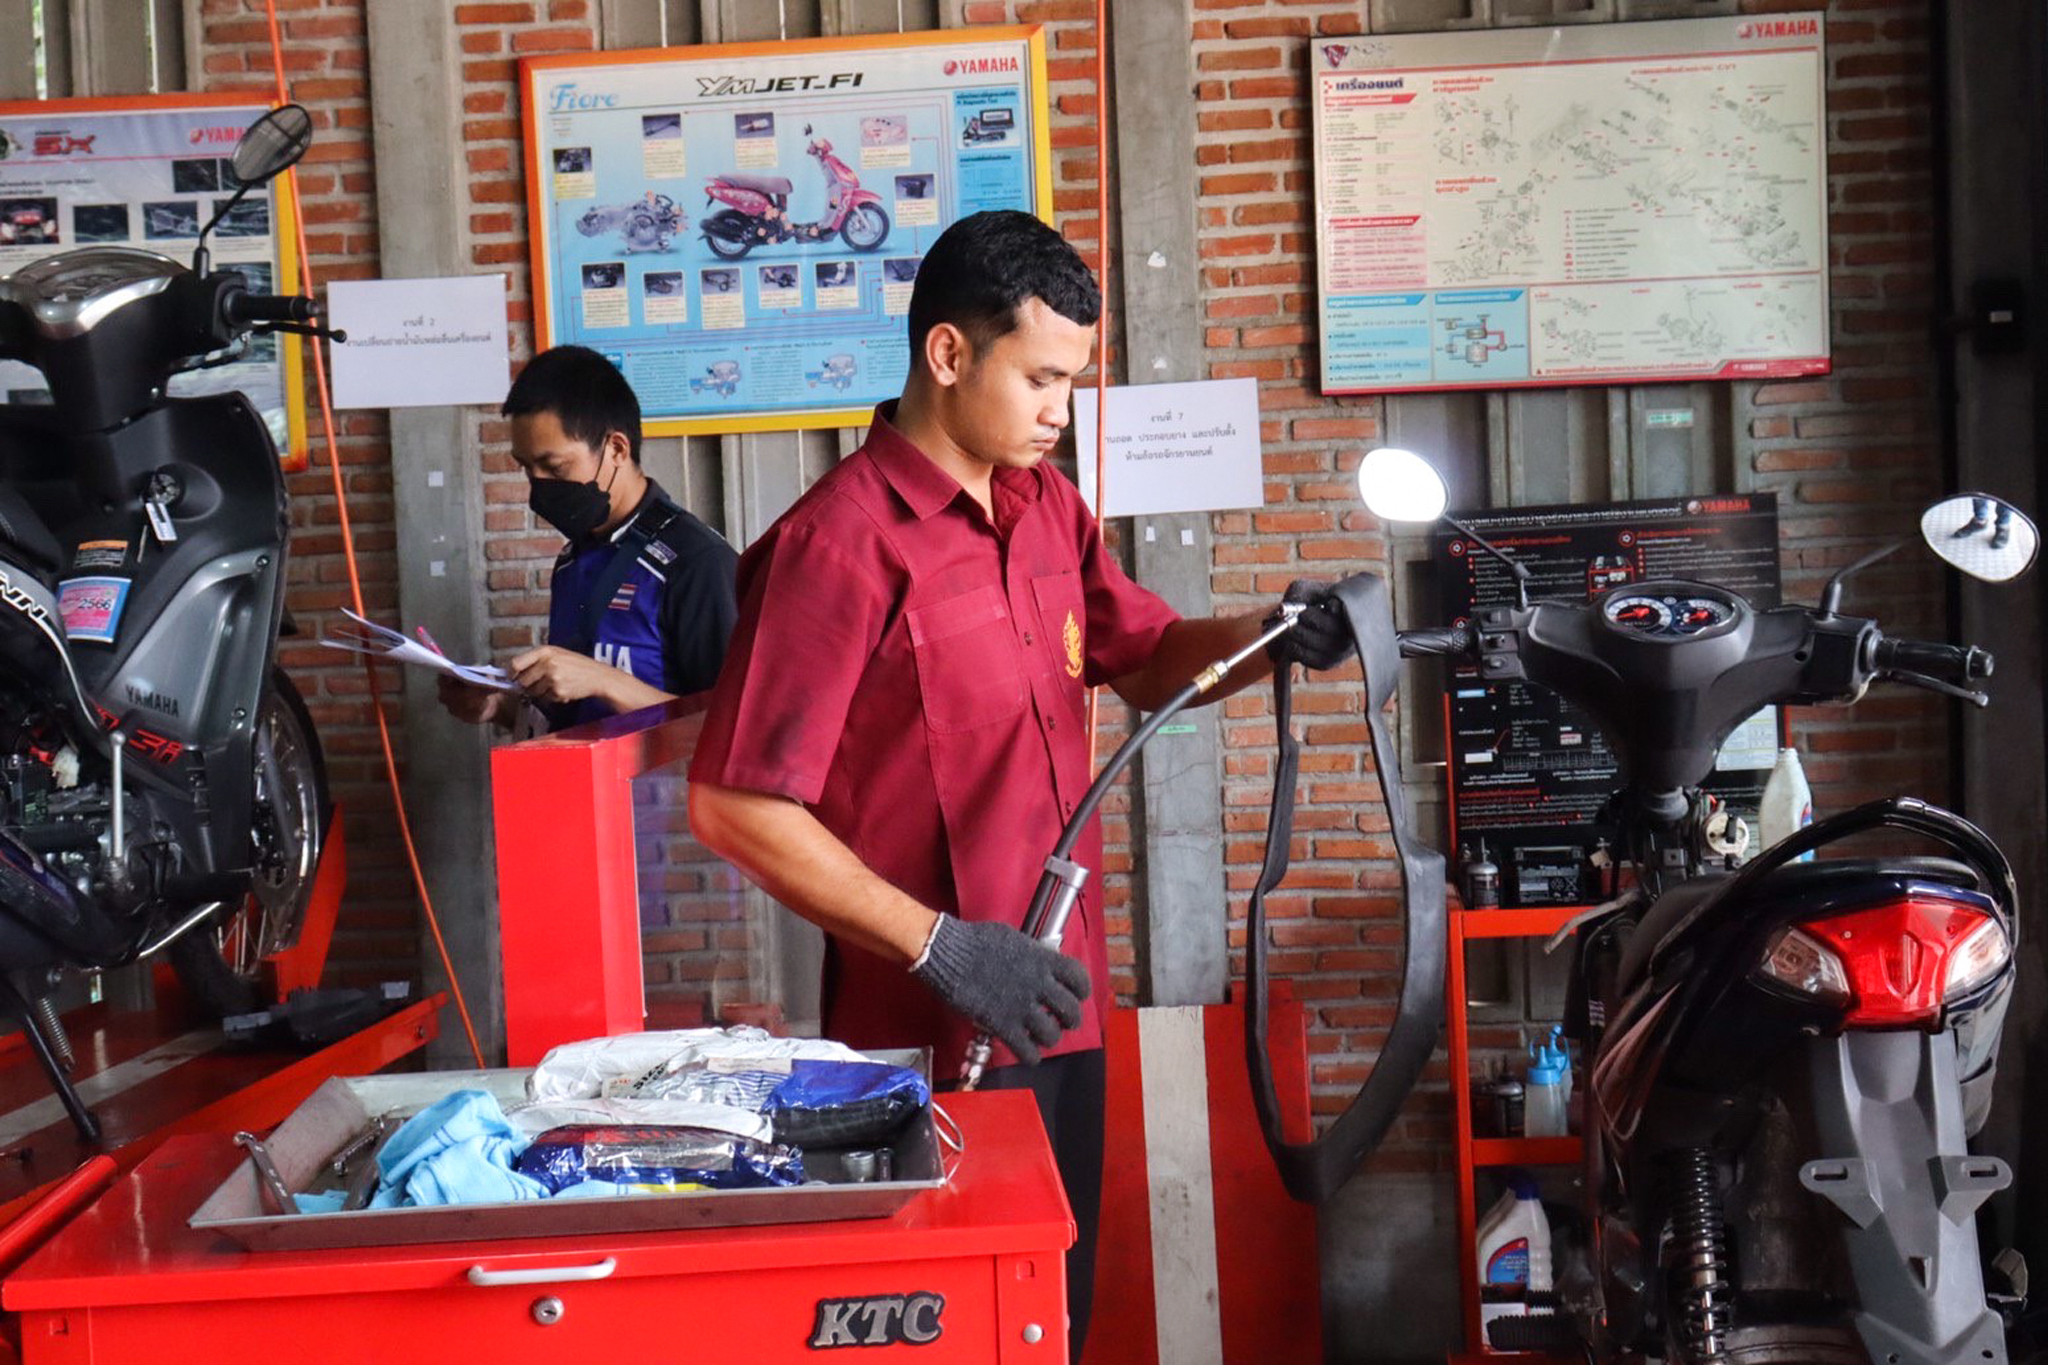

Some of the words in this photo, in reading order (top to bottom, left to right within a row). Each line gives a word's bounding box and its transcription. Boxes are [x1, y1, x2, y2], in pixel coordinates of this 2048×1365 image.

[1755, 20, 1817, 37] YAMAHA
[960, 56, 1018, 73] YAMAHA
[550, 84, 620, 109] Fiore
[429, 318, 436, 327] 2
[1150, 410, 1173, 423] งานที่
[1178, 413, 1184, 421] 7
[1105, 432, 1132, 444] านถอด
[1138, 430, 1187, 443] ประกอบยาง
[1192, 422, 1237, 439] และปรับตั้ง
[1702, 499, 1751, 514] YAMAHA
[78, 598, 112, 611] 2566
[126, 685, 180, 717] YAMAHA
[814, 1296, 941, 1346] KTC
